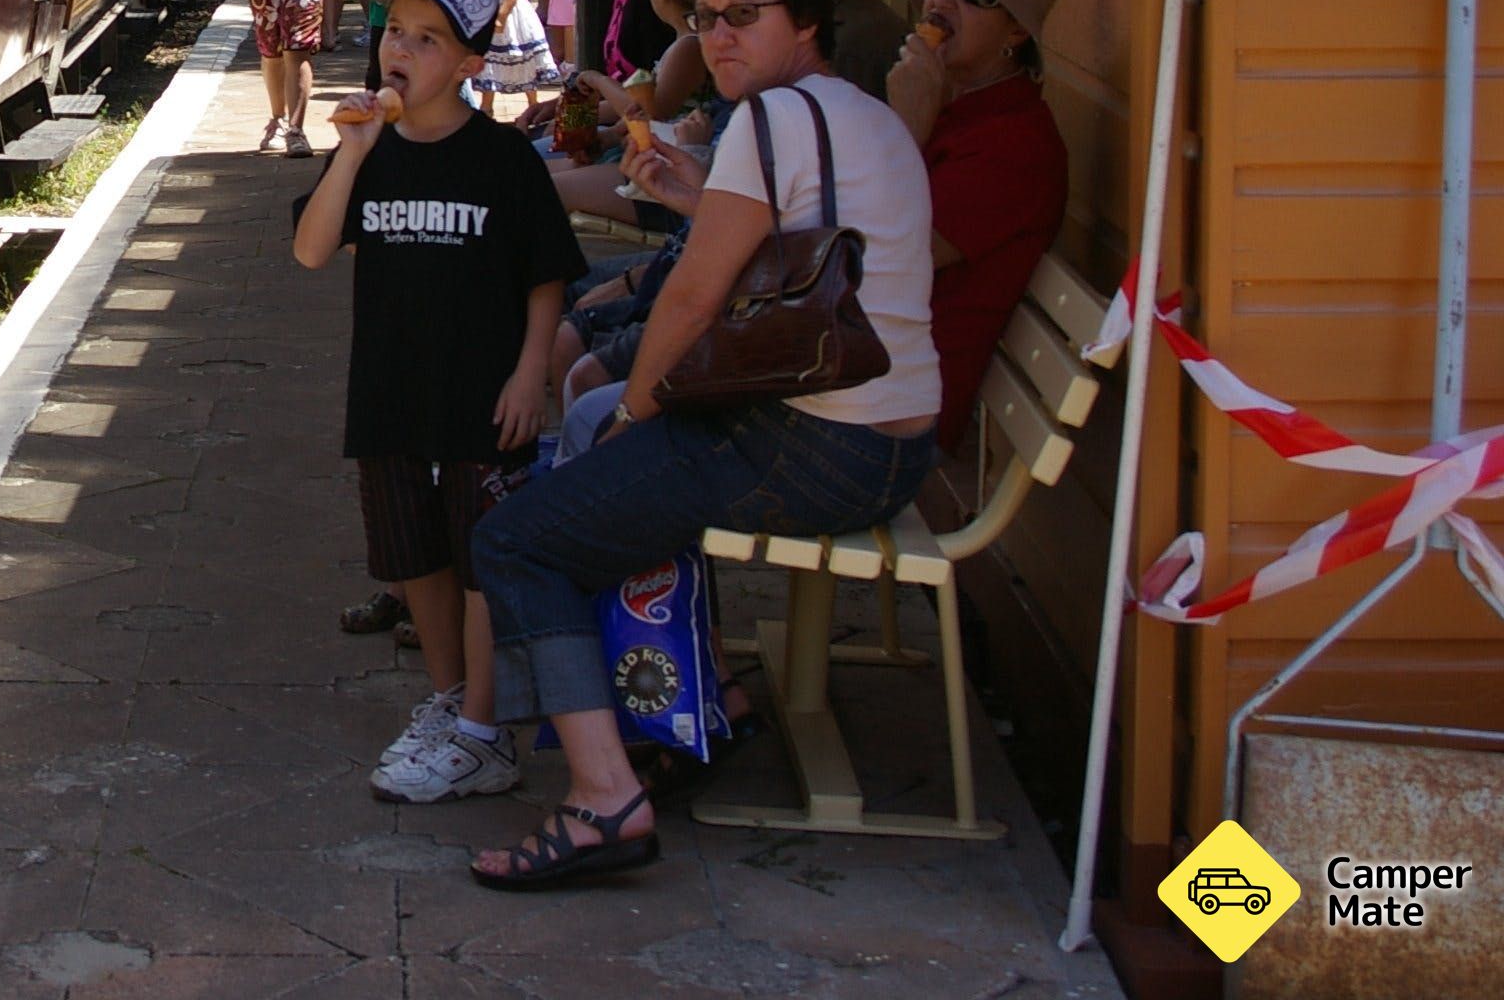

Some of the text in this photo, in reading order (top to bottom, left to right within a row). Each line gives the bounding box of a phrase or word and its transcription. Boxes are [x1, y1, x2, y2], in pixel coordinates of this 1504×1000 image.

[362, 200, 489, 236] SECURITY
[418, 231, 464, 246] Paradise
[615, 649, 678, 689] RED ROCK
[625, 695, 670, 713] DELI
